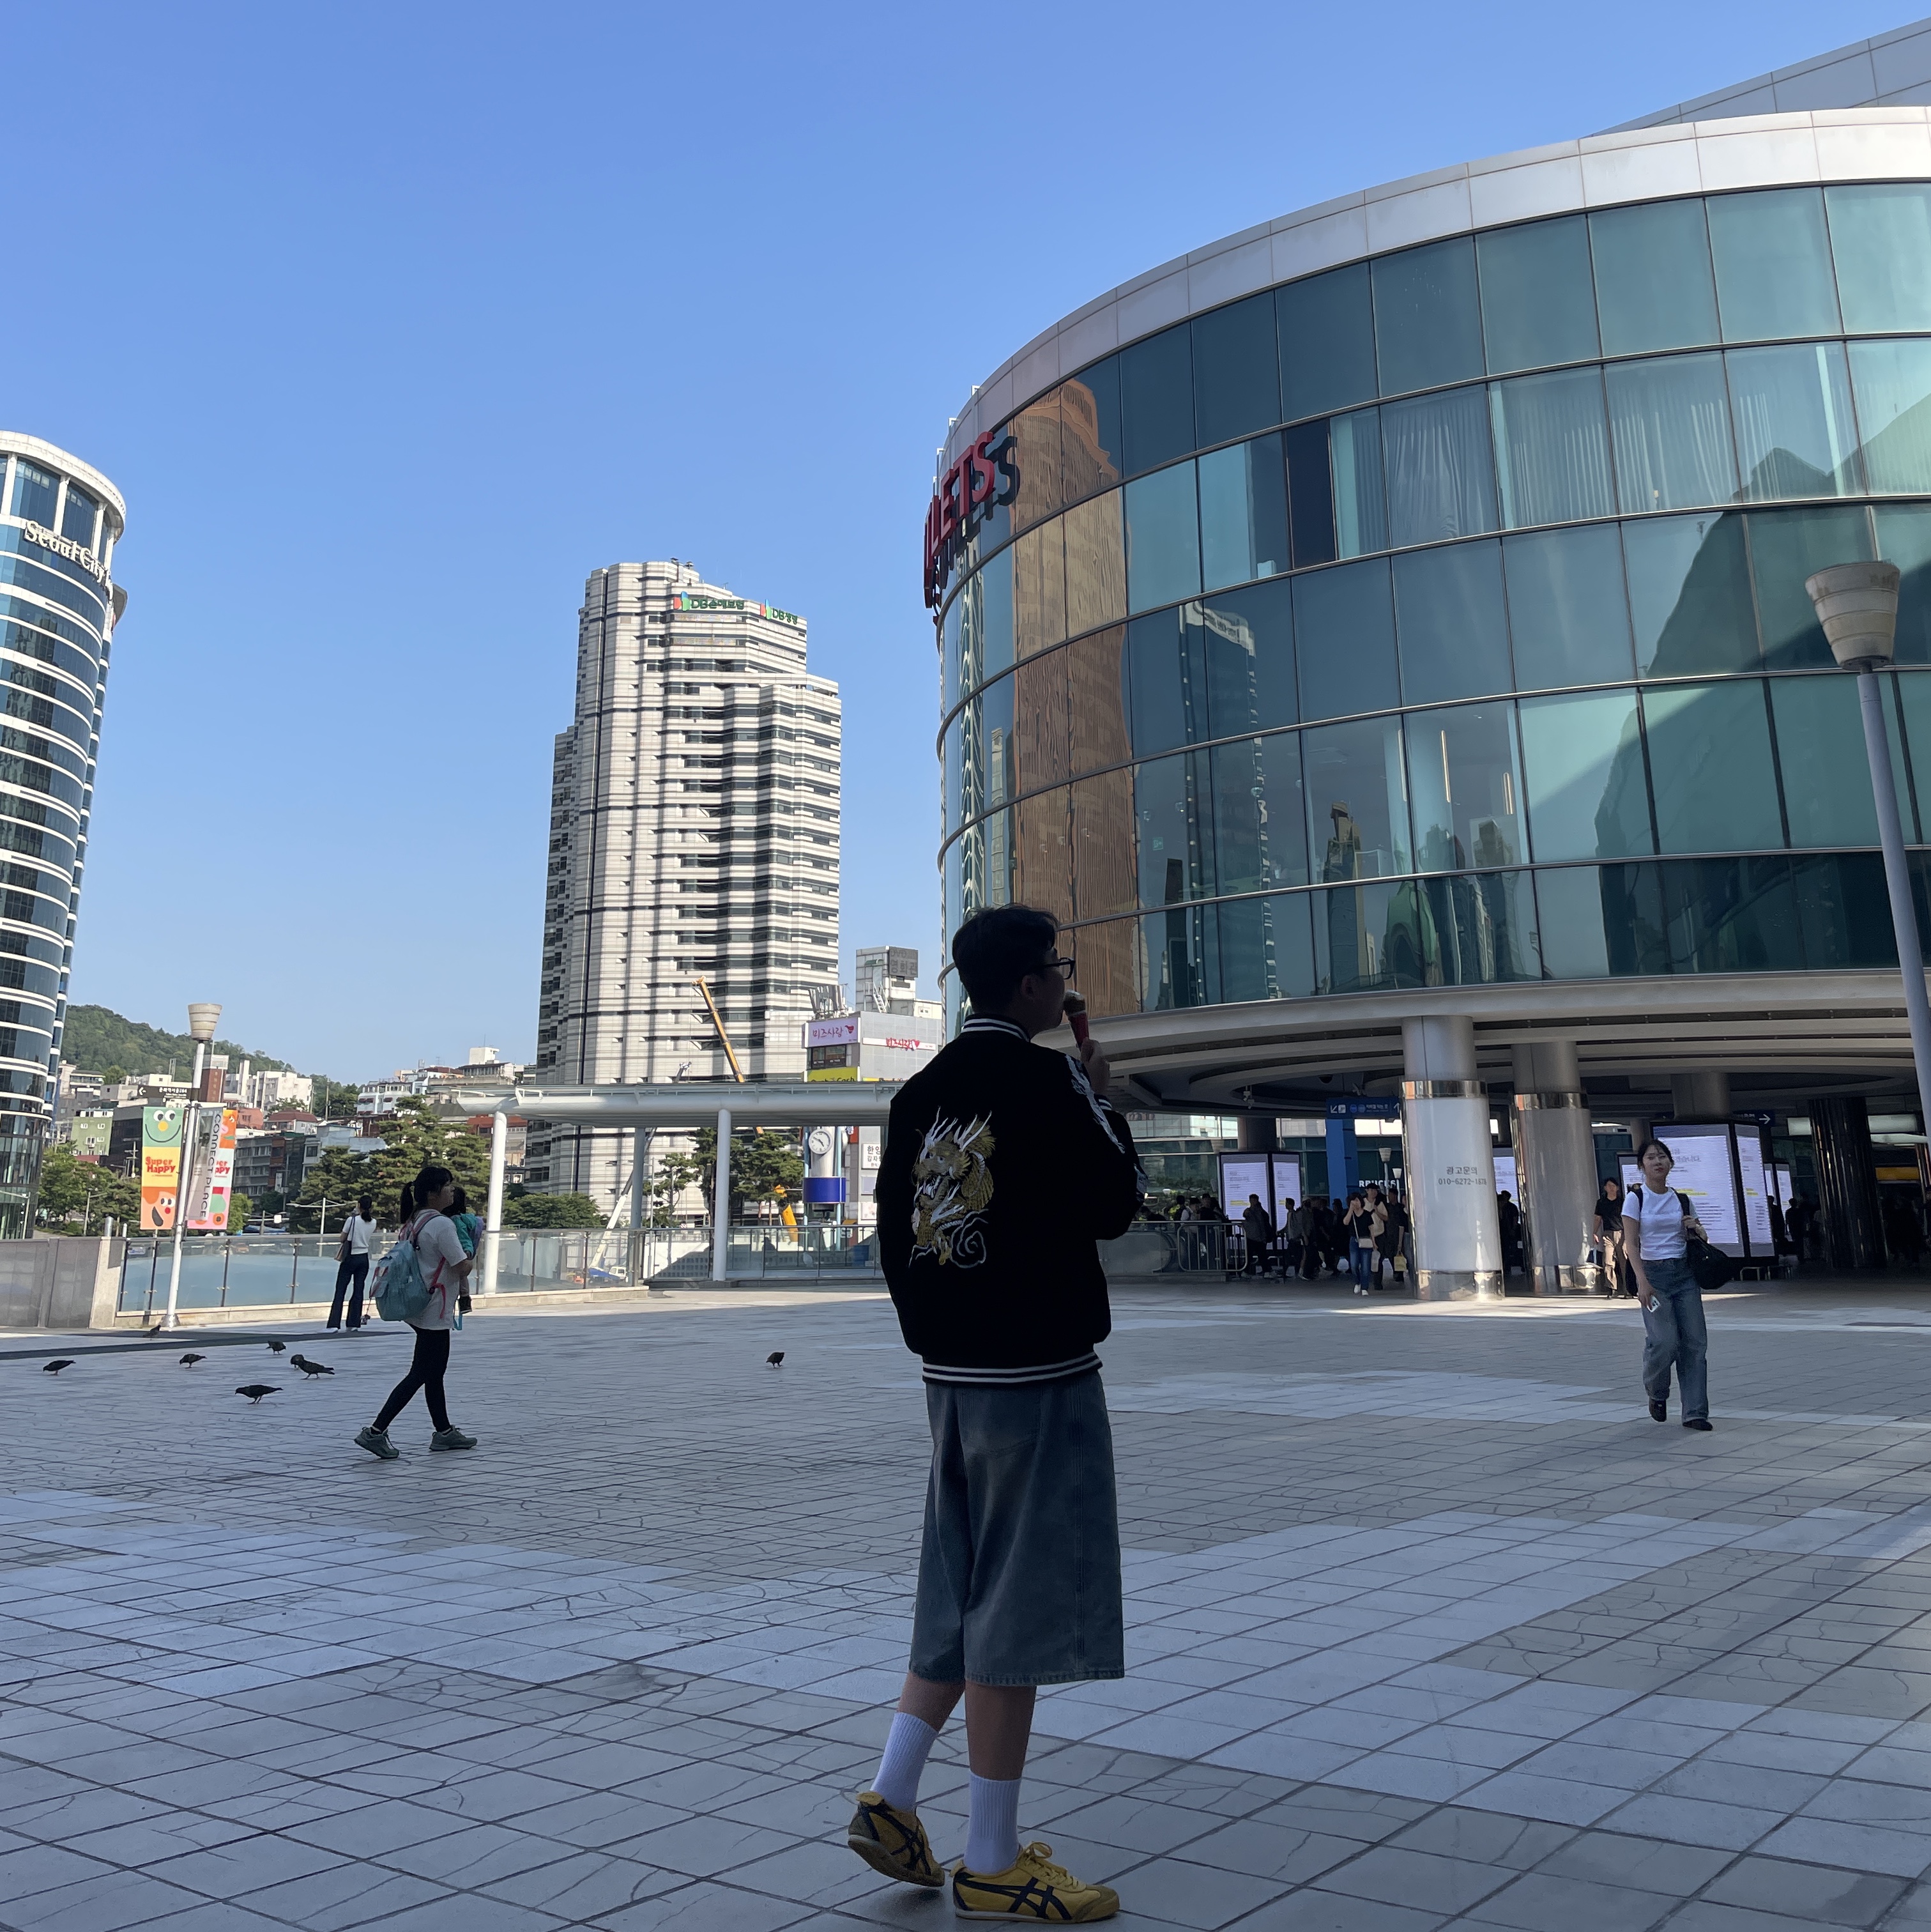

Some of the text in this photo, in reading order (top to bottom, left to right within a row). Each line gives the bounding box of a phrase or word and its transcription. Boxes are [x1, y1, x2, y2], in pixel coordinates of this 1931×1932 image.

[25, 520, 79, 562] Seoul
[812, 1026, 844, 1039] 미즈사랑
[145, 1156, 172, 1166] Super
[1446, 1166, 1477, 1175] 광고문의
